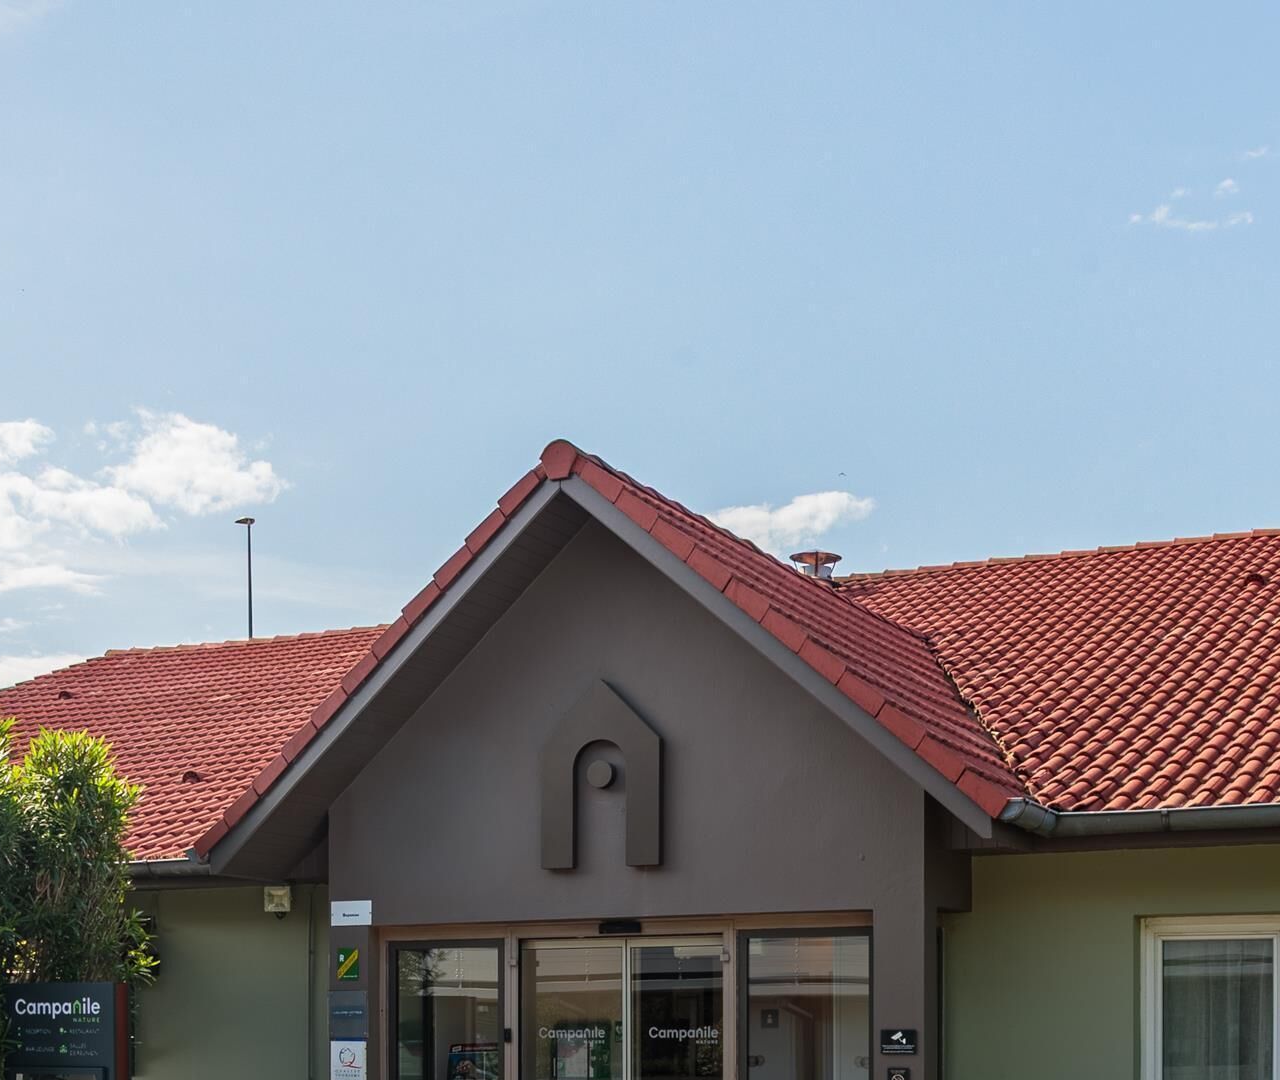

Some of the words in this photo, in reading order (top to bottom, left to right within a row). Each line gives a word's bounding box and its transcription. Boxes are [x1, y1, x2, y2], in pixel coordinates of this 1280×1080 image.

[15, 997, 101, 1019] Campanile
[538, 1026, 606, 1042] Campanile
[648, 1025, 719, 1042] Campanile
